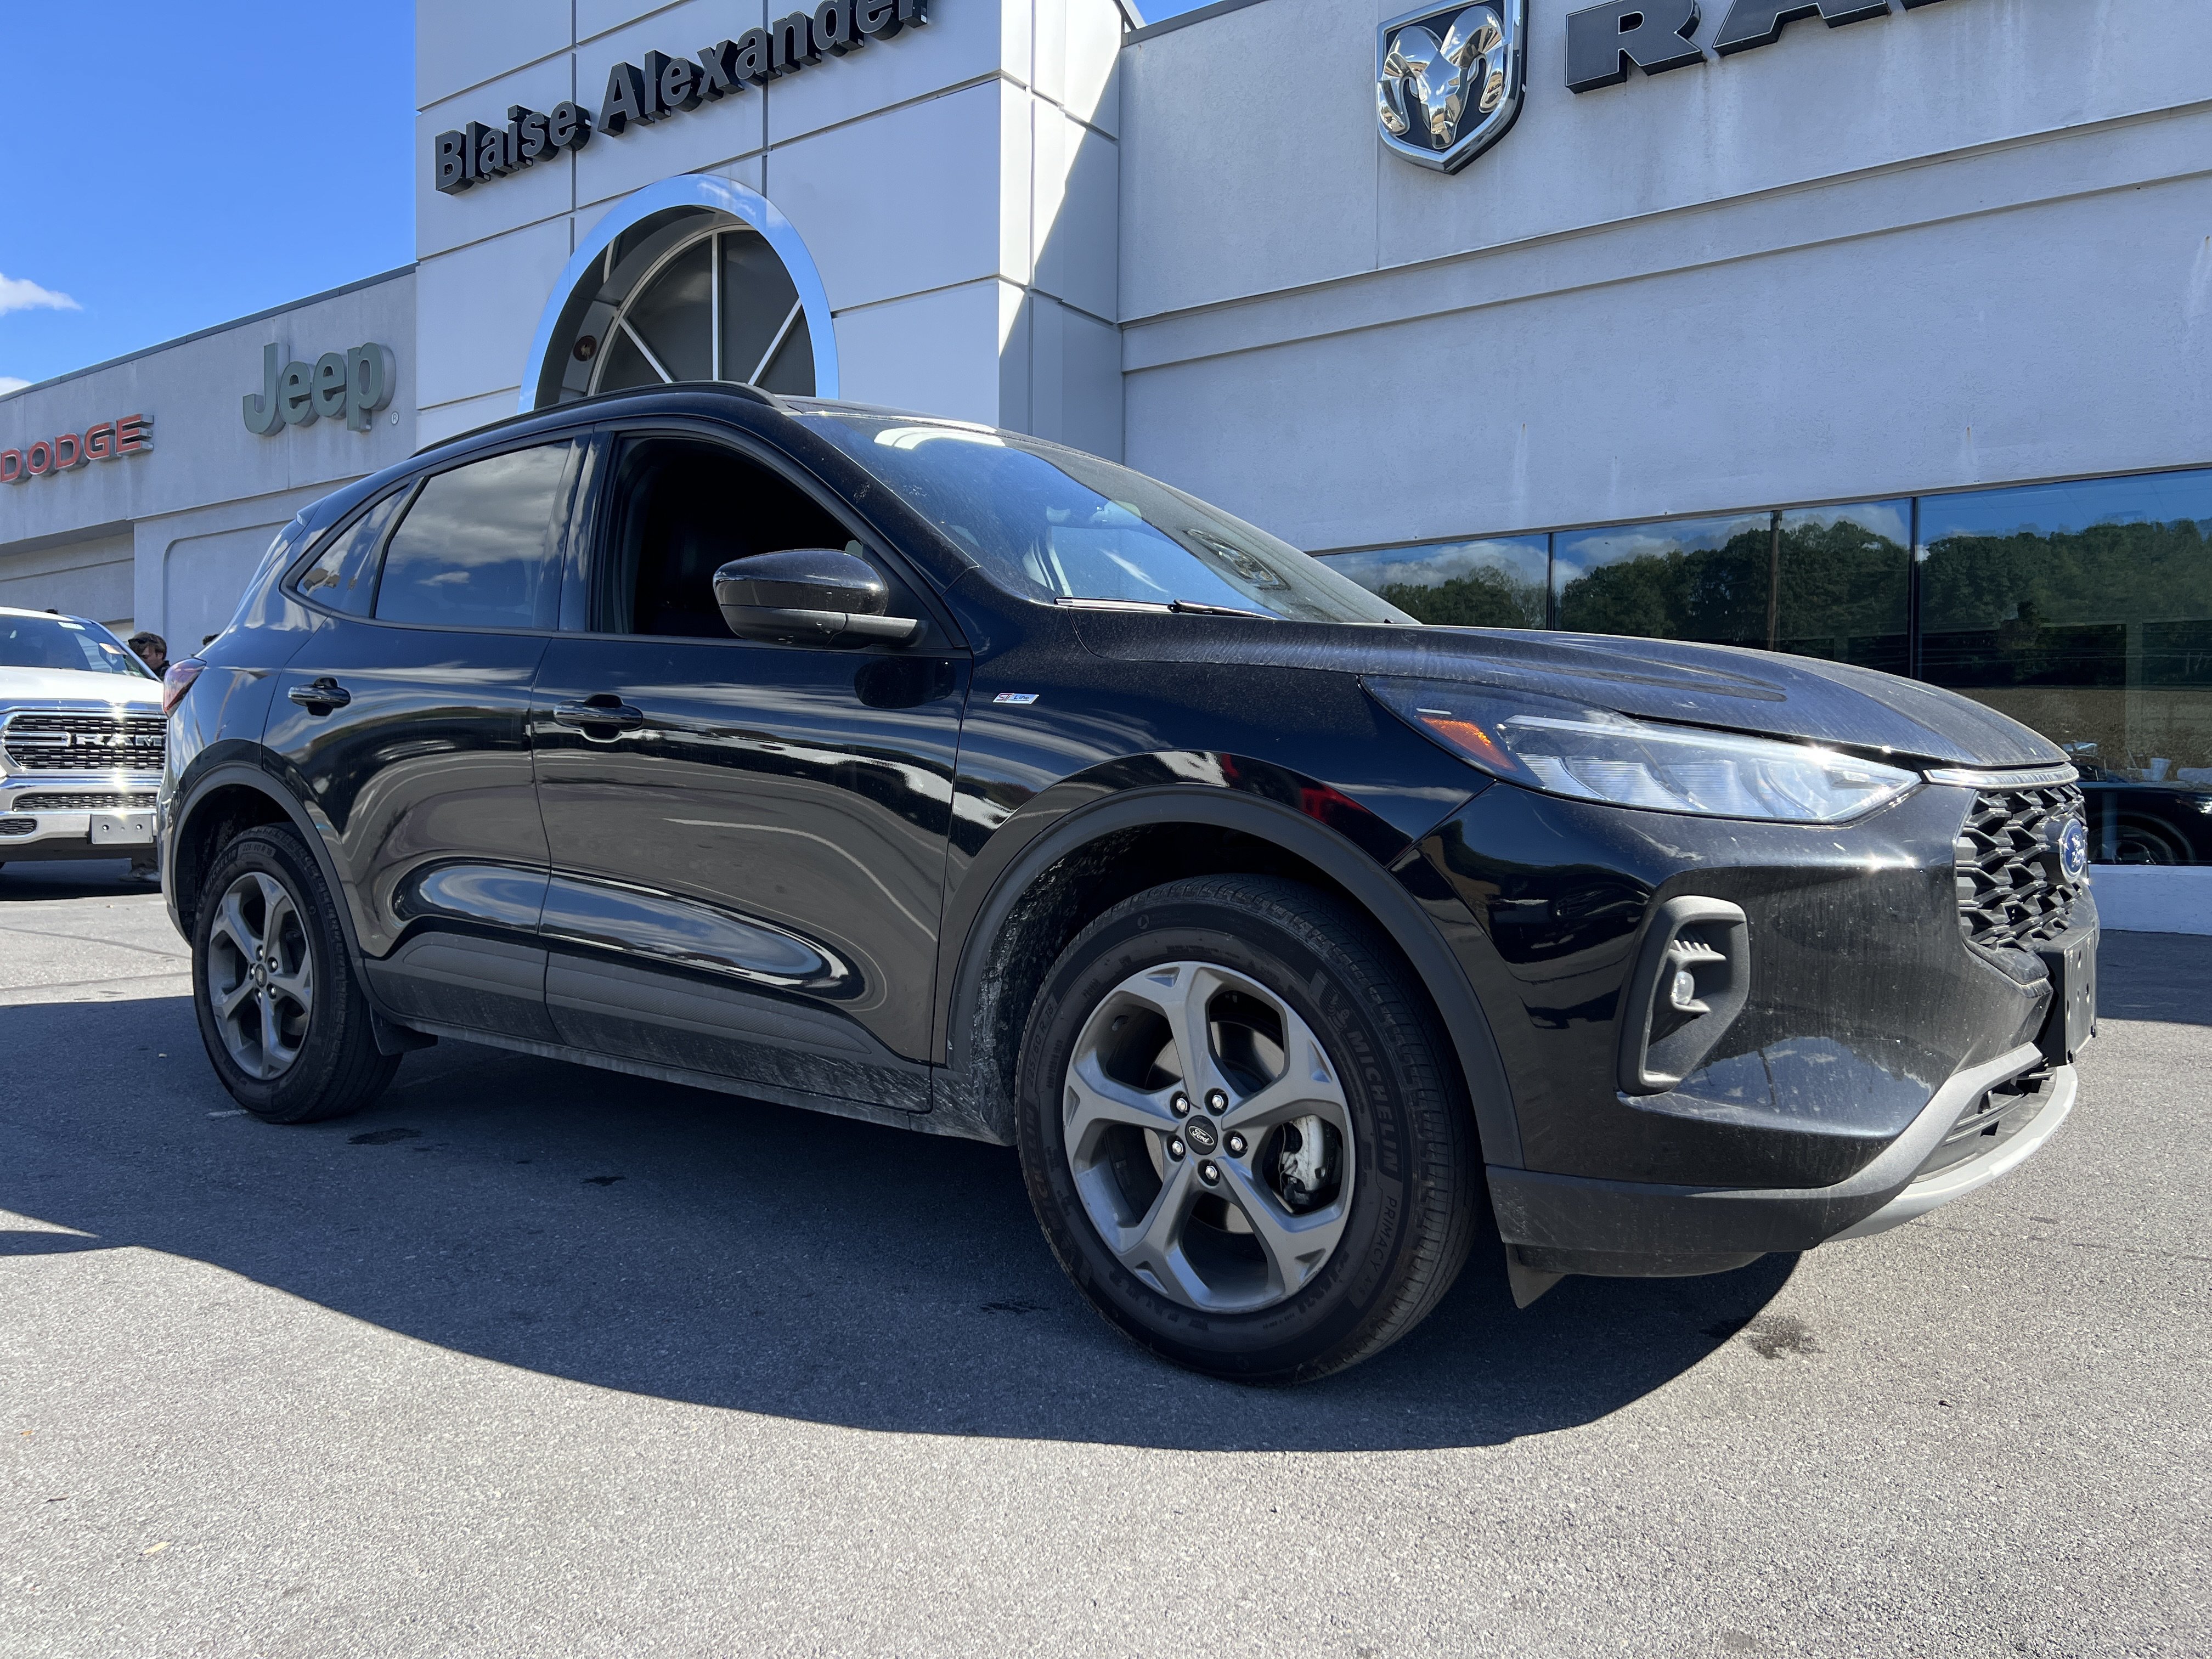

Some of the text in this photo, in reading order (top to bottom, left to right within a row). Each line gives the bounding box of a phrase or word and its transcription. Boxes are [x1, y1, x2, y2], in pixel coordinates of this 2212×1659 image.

[436, 101, 591, 195] Blaise
[242, 342, 396, 437] Jeep
[0, 413, 154, 485] DODGE
[996, 693, 1013, 702] ST
[76, 733, 162, 747] RAM
[1026, 1003, 1054, 1087] 225/60 R 18
[1192, 1128, 1210, 1143] Ford
[1345, 1030, 1398, 1173] MICHELIN
[1370, 1195, 1397, 1273] PRIMACY
